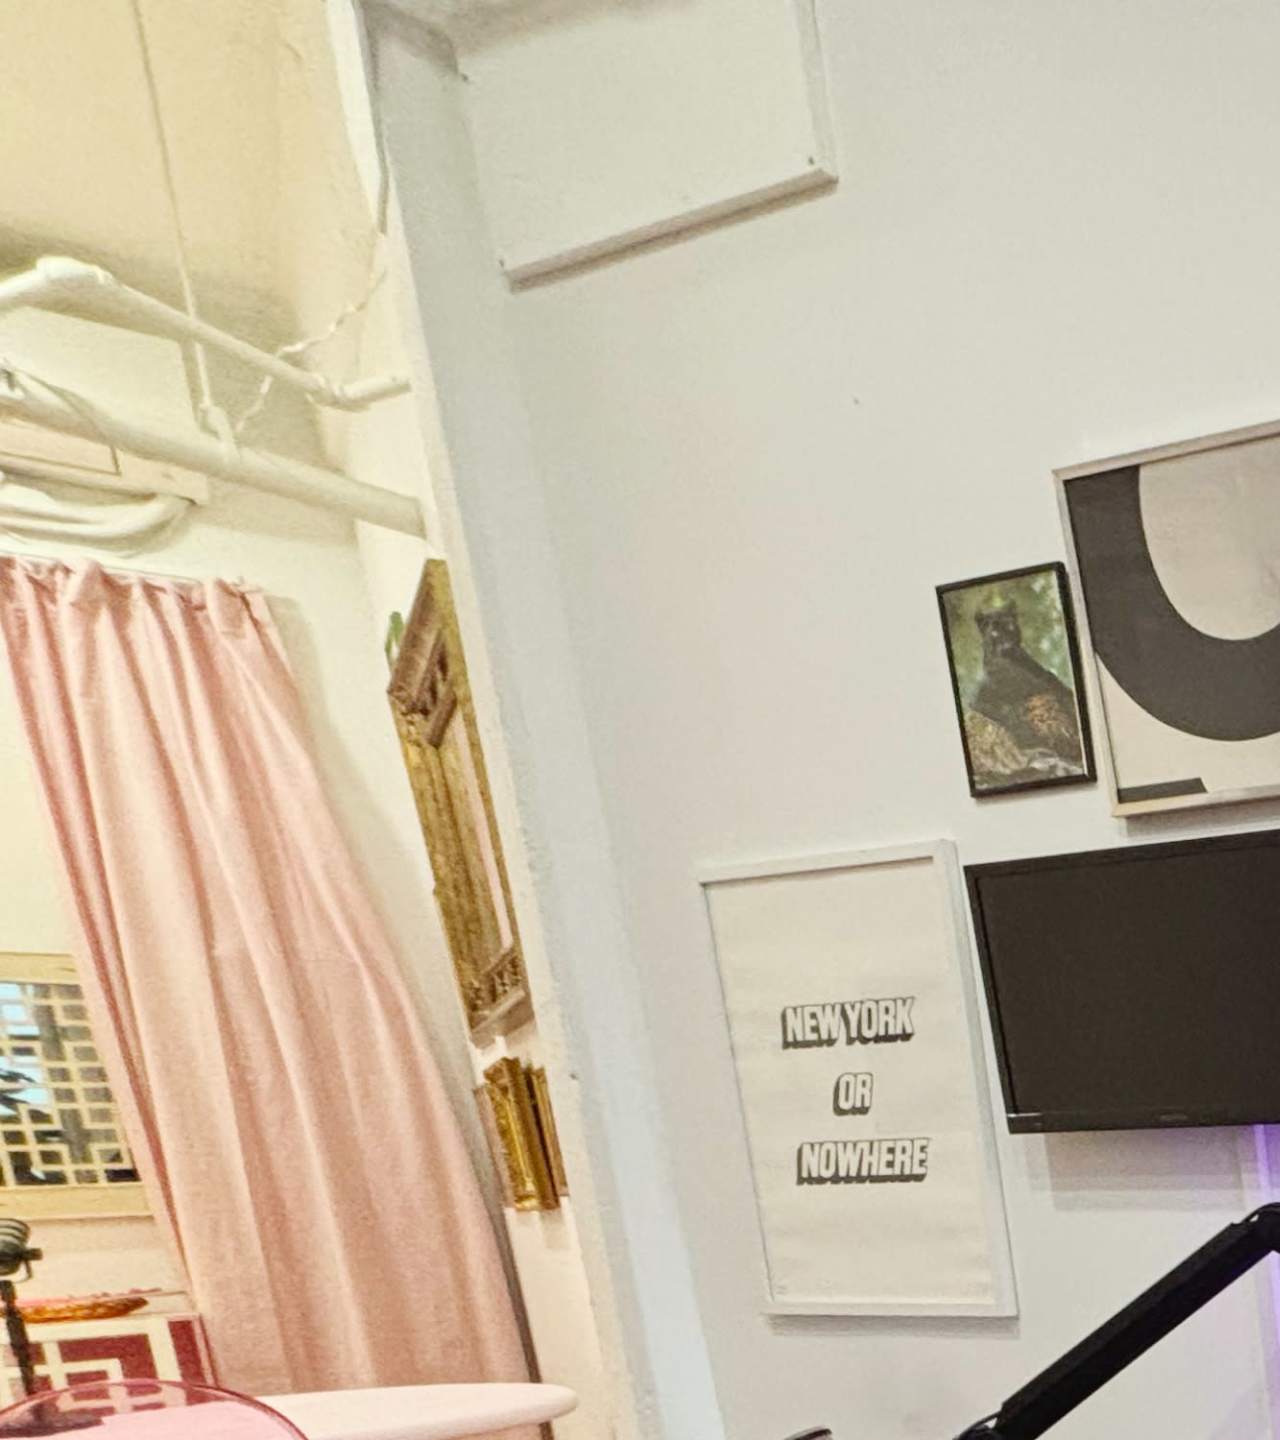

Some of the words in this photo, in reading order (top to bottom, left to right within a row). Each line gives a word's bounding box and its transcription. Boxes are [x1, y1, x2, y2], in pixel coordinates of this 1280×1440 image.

[781, 1001, 842, 1050] NEW
[843, 996, 915, 1046] YORK
[832, 1071, 874, 1116] OR
[796, 1136, 931, 1186] NOWHERE
